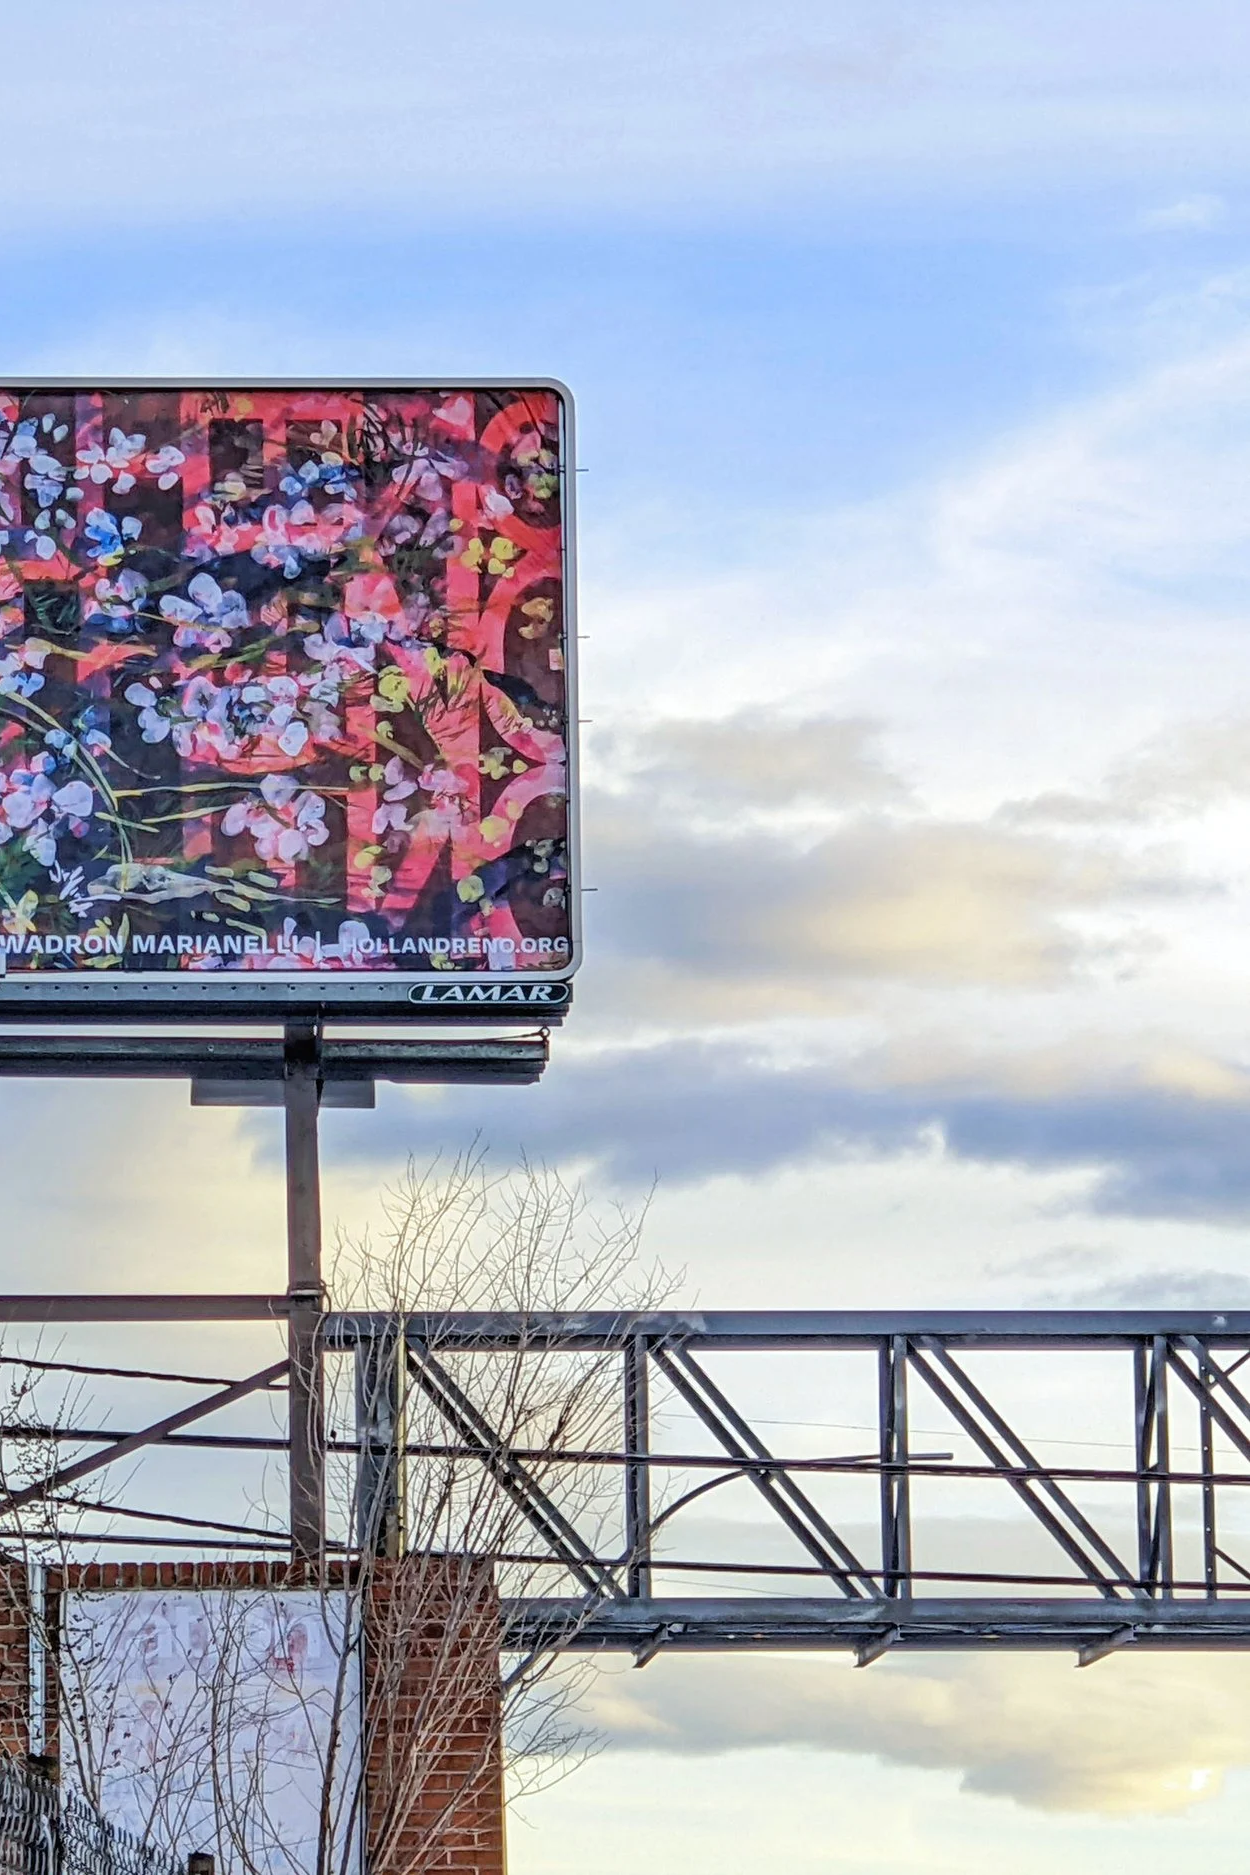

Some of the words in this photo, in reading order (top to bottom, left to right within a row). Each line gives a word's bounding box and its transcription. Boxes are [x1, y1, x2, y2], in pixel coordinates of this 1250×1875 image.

[132, 934, 298, 954] MARIANELLI
[342, 936, 569, 954] HOLLANDRENO.ORG
[421, 985, 553, 1001] LAMAR
